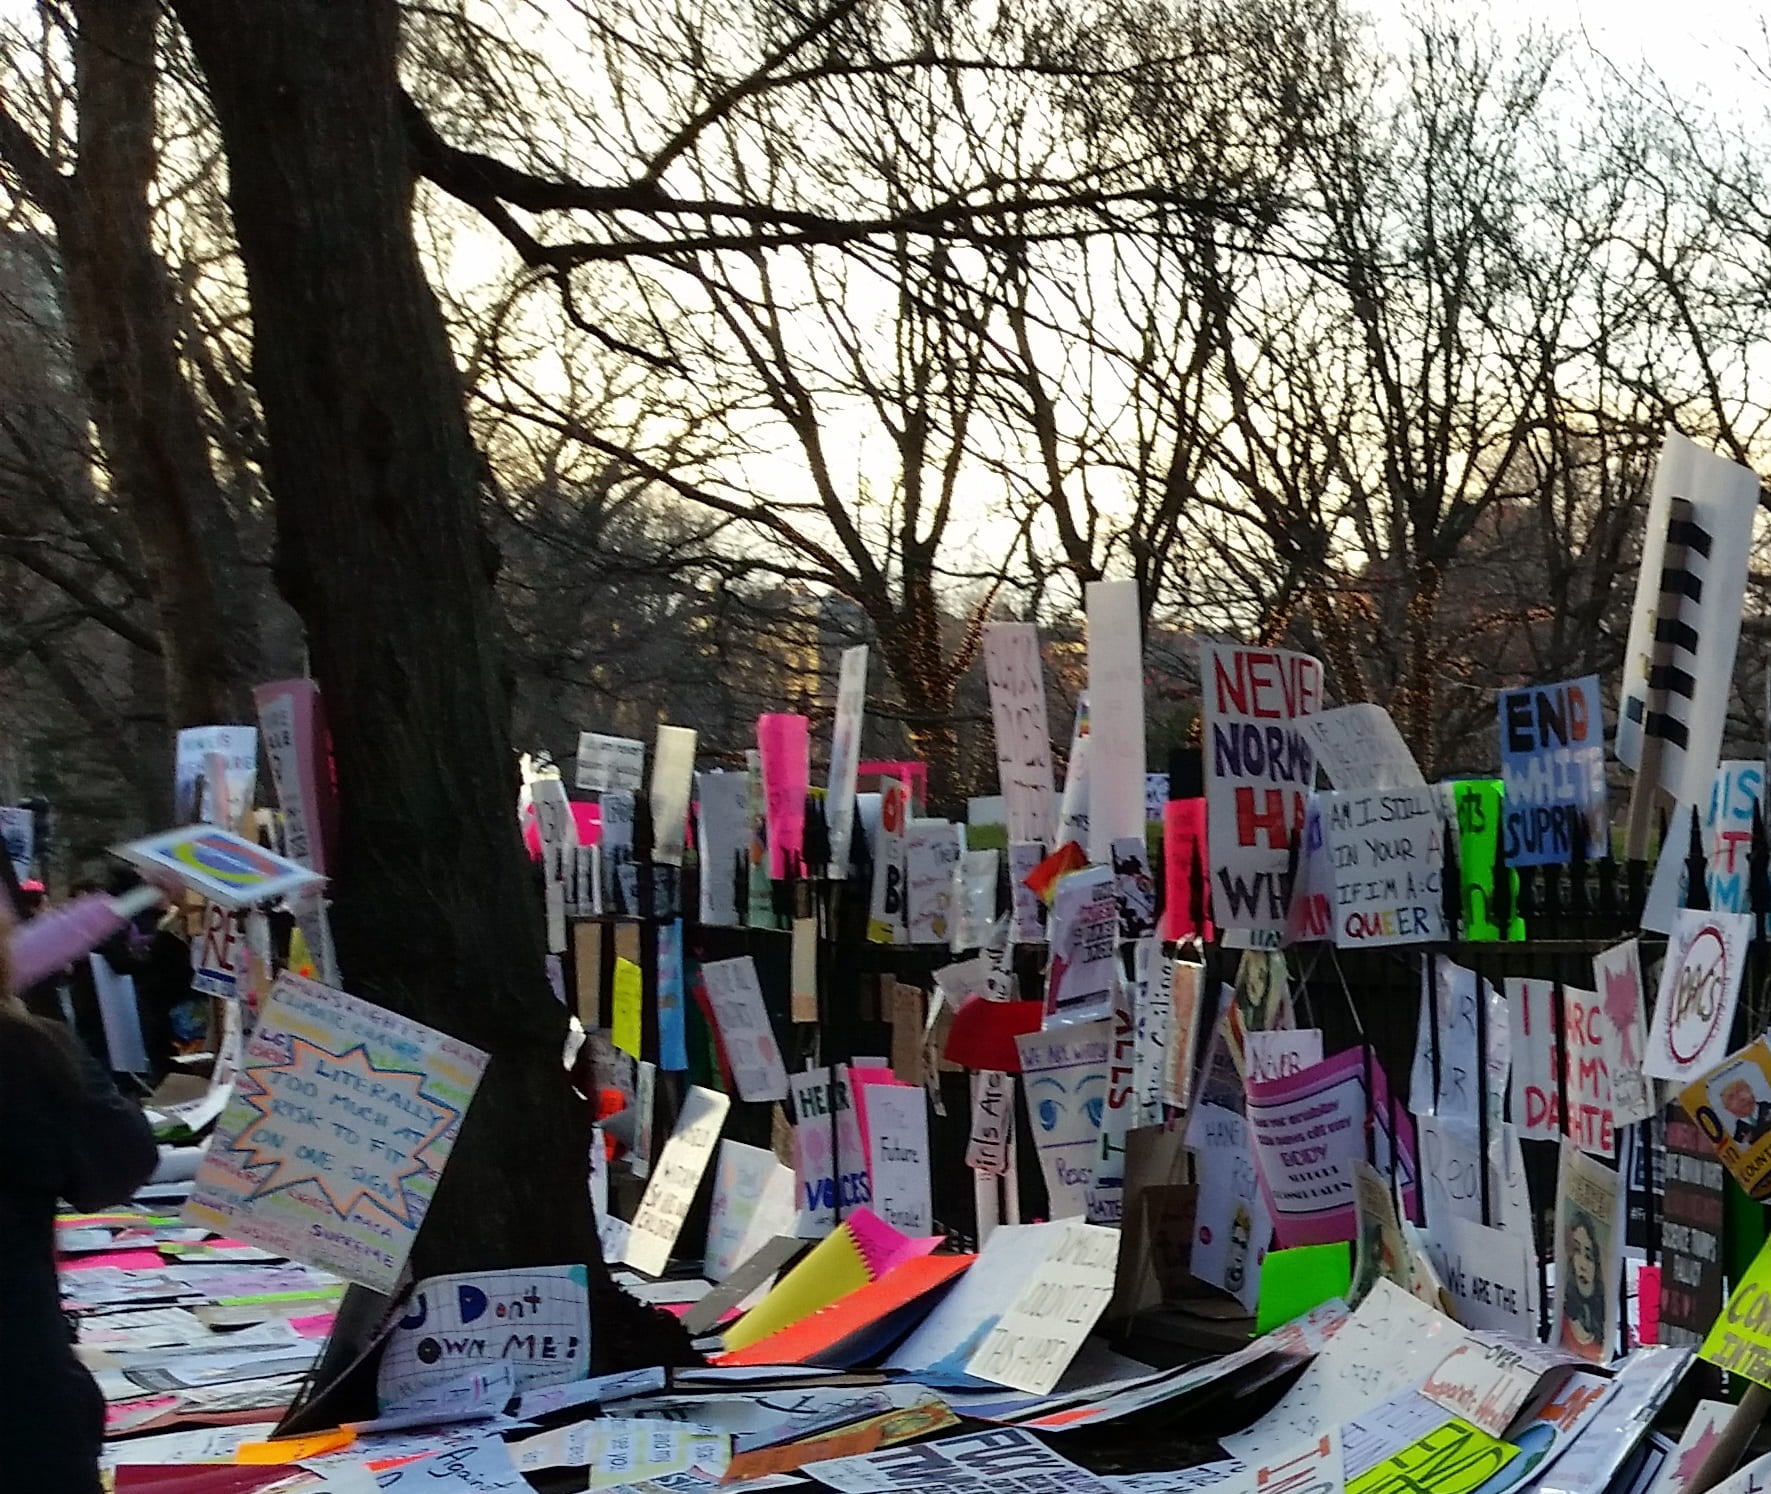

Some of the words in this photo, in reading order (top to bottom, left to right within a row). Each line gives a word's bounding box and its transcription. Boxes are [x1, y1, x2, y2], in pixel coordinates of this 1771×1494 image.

[1506, 685, 1588, 754] END
[1334, 846, 1358, 869] IN
[1368, 839, 1414, 863] YOUR
[1346, 907, 1430, 939] QUEER
[270, 1070, 318, 1097] TOO
[329, 1094, 389, 1127] MUCH
[392, 1127, 426, 1146] AT
[314, 1059, 446, 1129] LITERALLY
[251, 1129, 286, 1148] ON
[295, 1143, 336, 1171] ONE
[271, 1102, 323, 1128] RISK
[331, 1121, 360, 1145] TO
[370, 1137, 407, 1165] FIT
[309, 1223, 395, 1268] SUPREME
